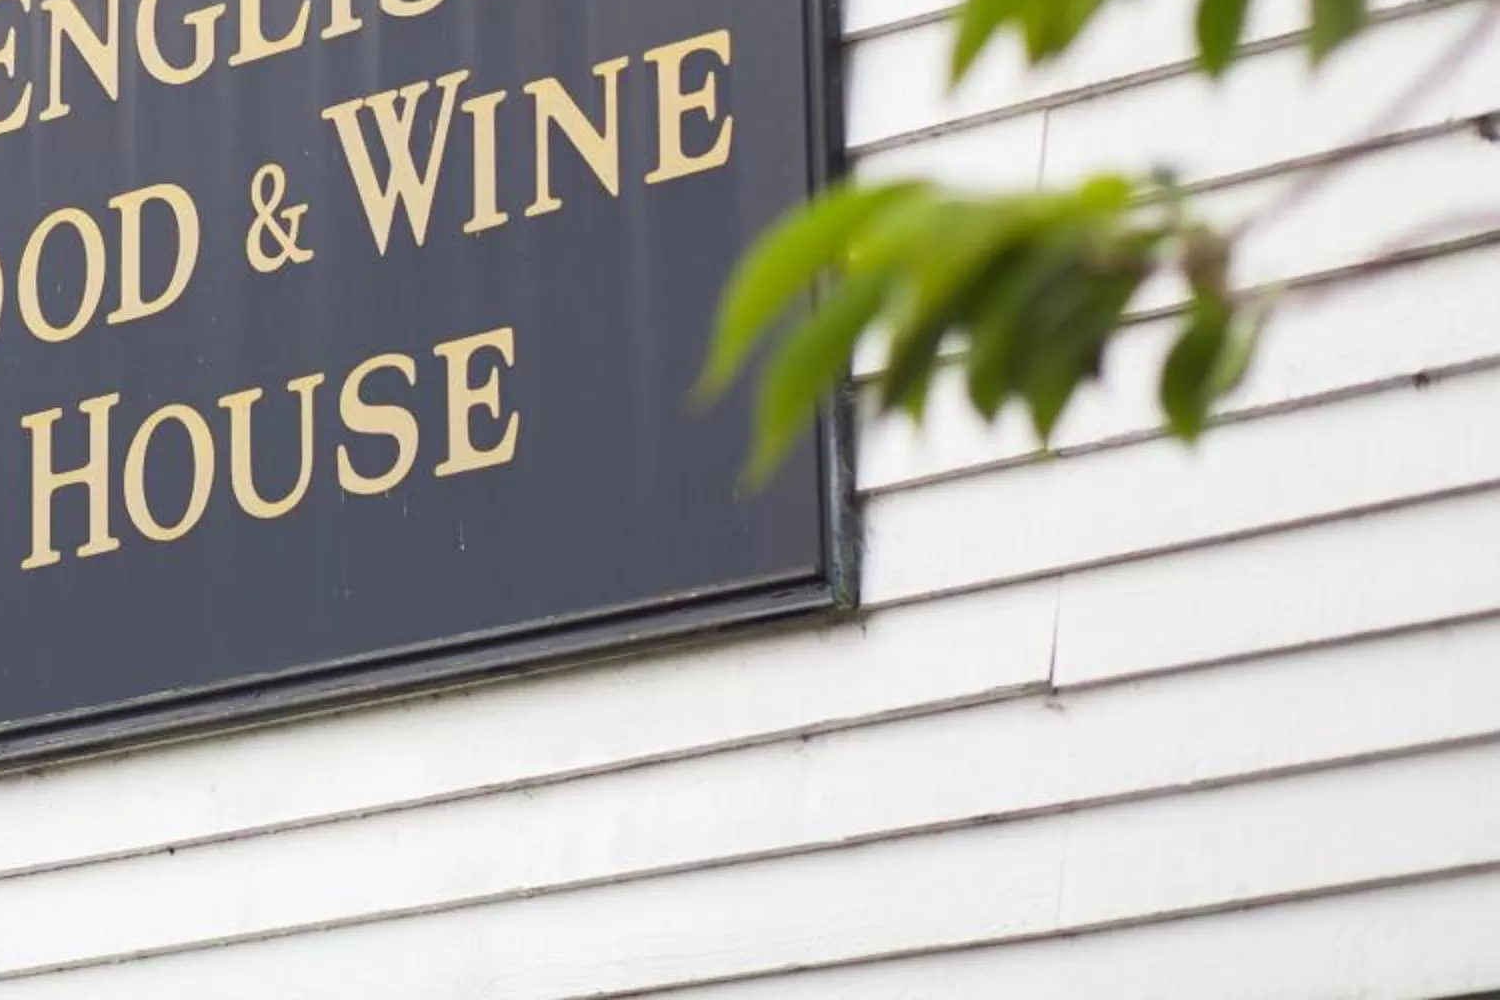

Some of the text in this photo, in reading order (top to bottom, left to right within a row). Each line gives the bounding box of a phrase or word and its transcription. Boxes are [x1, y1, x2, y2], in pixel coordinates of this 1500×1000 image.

[246, 163, 314, 273] &
[322, 30, 734, 257] WINE
[21, 327, 520, 571] HOUSE
